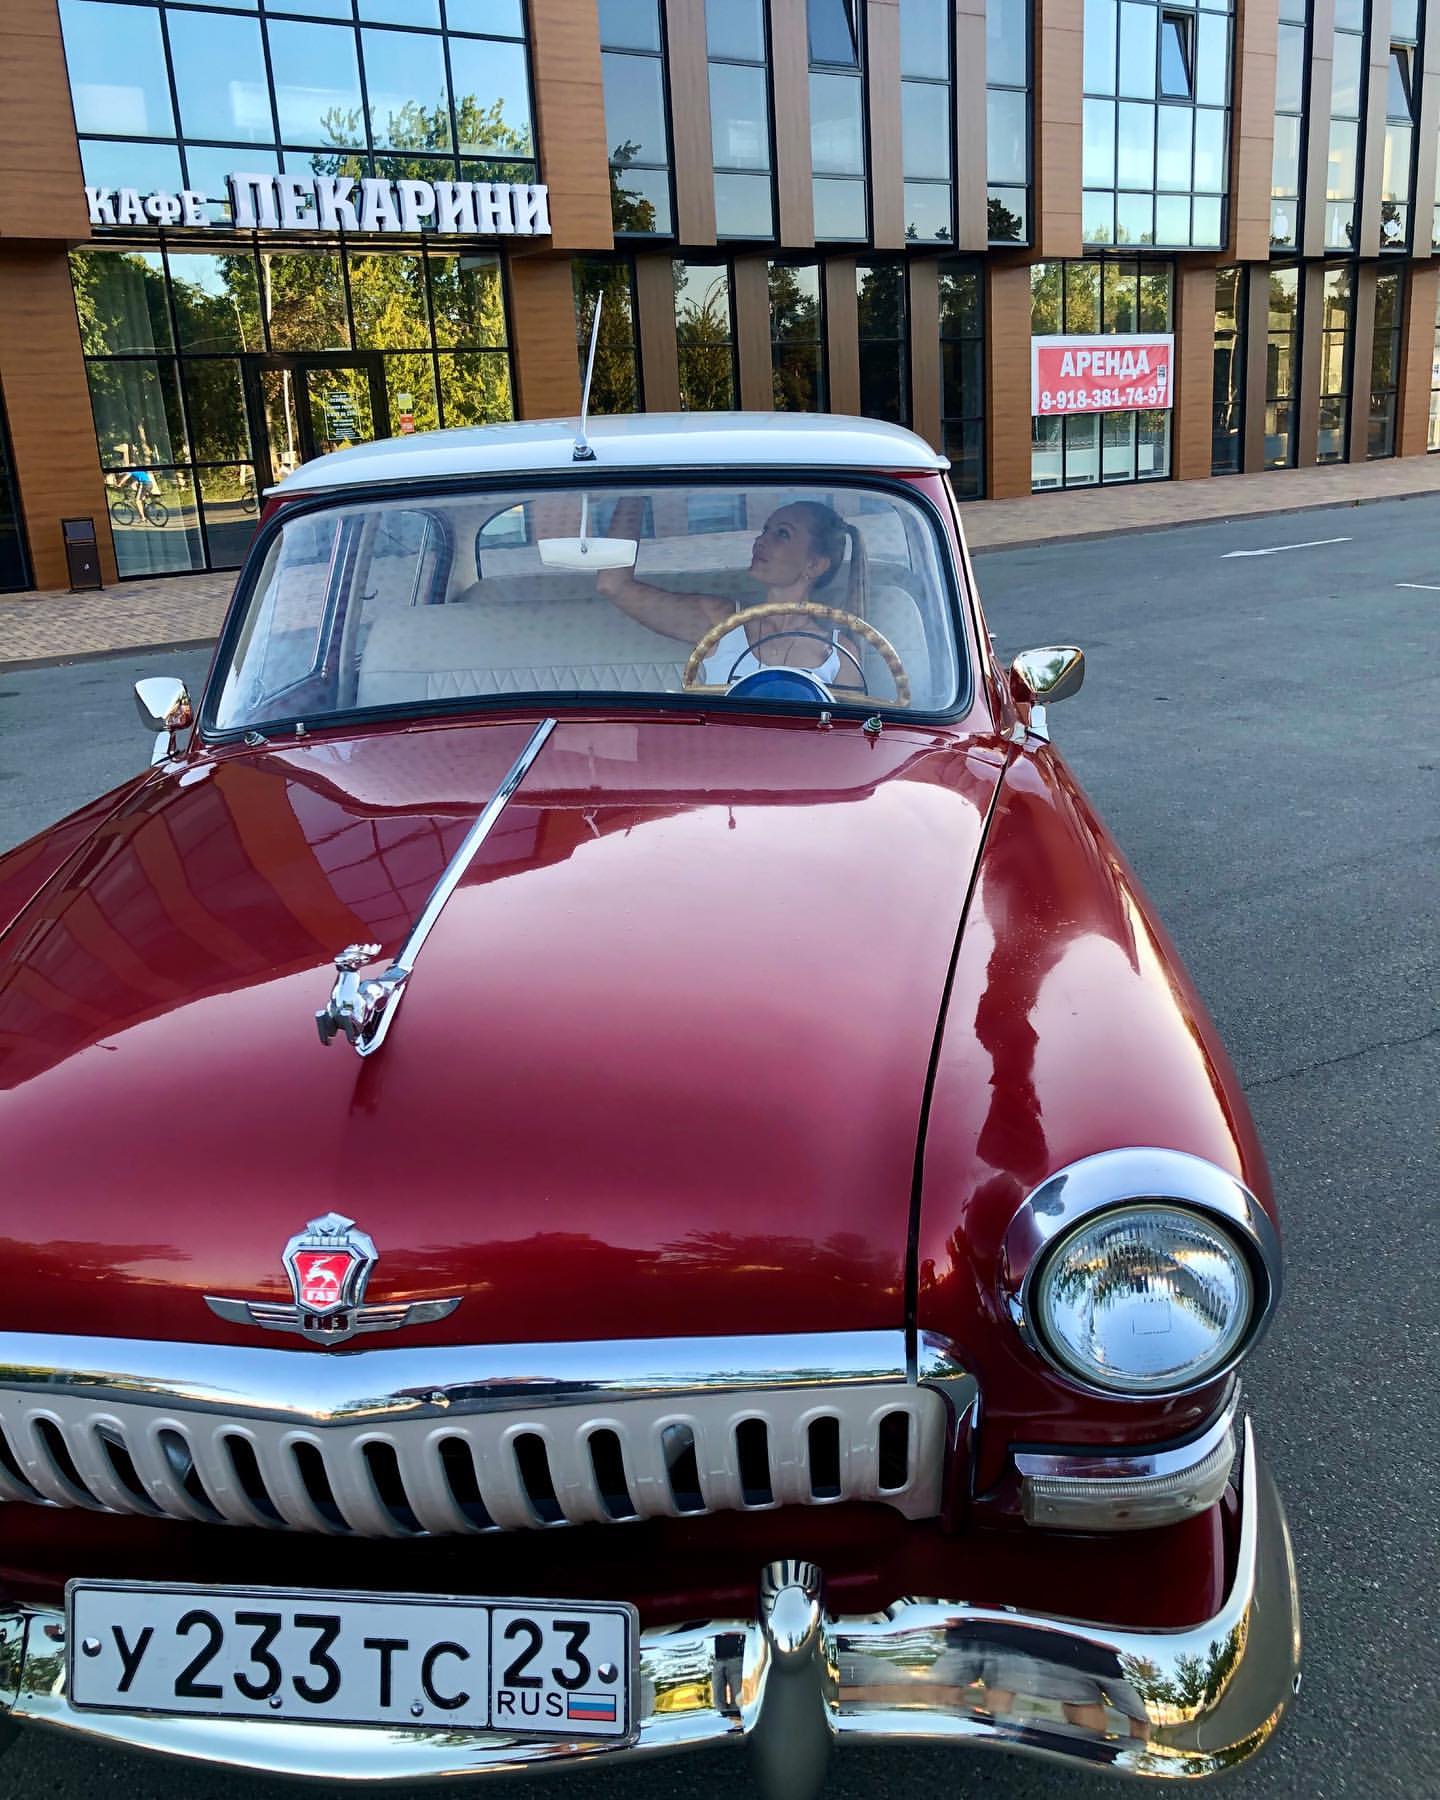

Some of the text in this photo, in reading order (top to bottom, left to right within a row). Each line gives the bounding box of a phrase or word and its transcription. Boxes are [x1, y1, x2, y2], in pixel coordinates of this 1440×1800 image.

[85, 172, 552, 235] КАФЕ ПЕКАРИНИ
[1060, 350, 1150, 380] АРЕНДА
[1041, 386, 1166, 410] 8-918-381-74-97
[503, 1618, 592, 1689] 23
[497, 1690, 563, 1717] RUS
